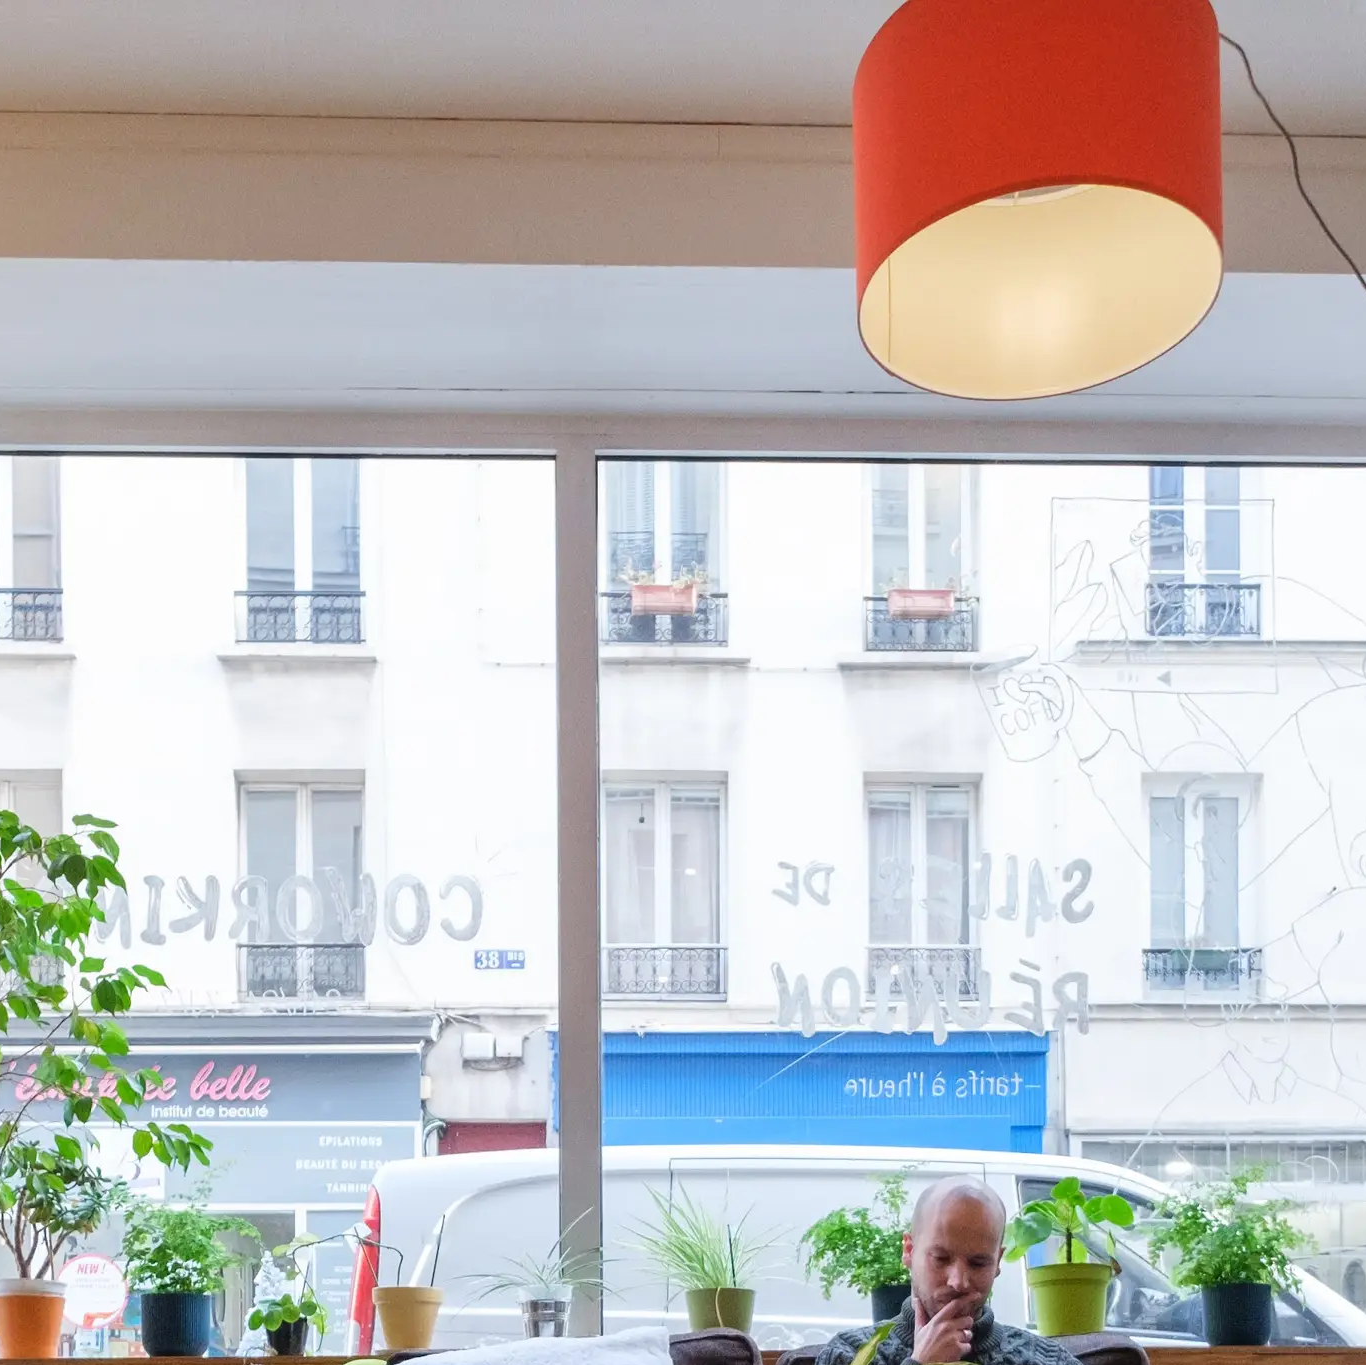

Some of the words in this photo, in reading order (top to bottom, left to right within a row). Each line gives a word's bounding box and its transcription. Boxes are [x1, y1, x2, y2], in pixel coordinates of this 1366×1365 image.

[477, 950, 500, 968] 38
[189, 1060, 271, 1101] belle
[151, 1105, 192, 1118] Institut
[195, 1105, 215, 1118] de
[218, 1104, 269, 1118] beauté
[77, 1264, 99, 1275] NEW
